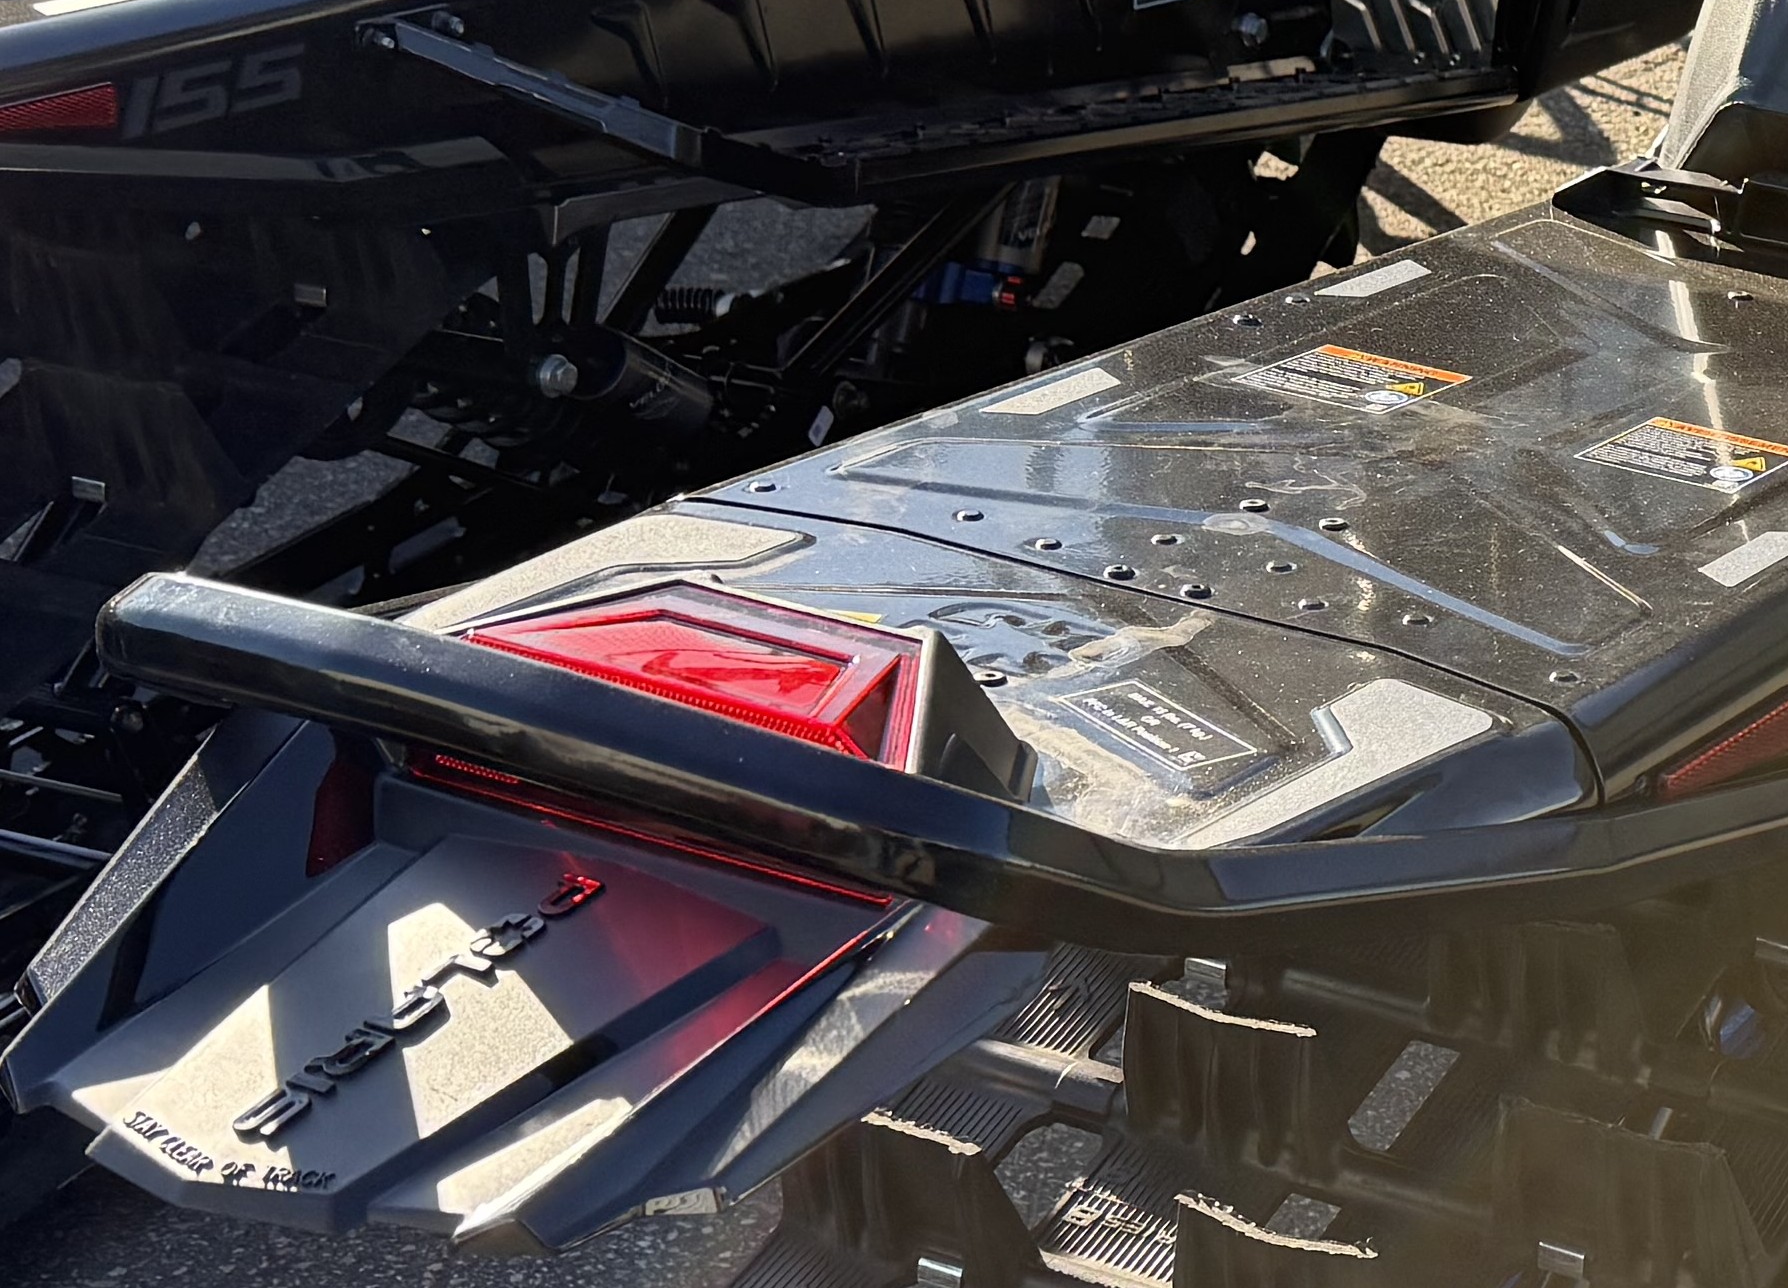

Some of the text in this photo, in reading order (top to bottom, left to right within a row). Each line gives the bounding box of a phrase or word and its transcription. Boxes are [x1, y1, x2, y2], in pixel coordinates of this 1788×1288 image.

[121, 43, 304, 140] 155
[122, 1110, 337, 1190] STAY CLEAR OF TRACK
